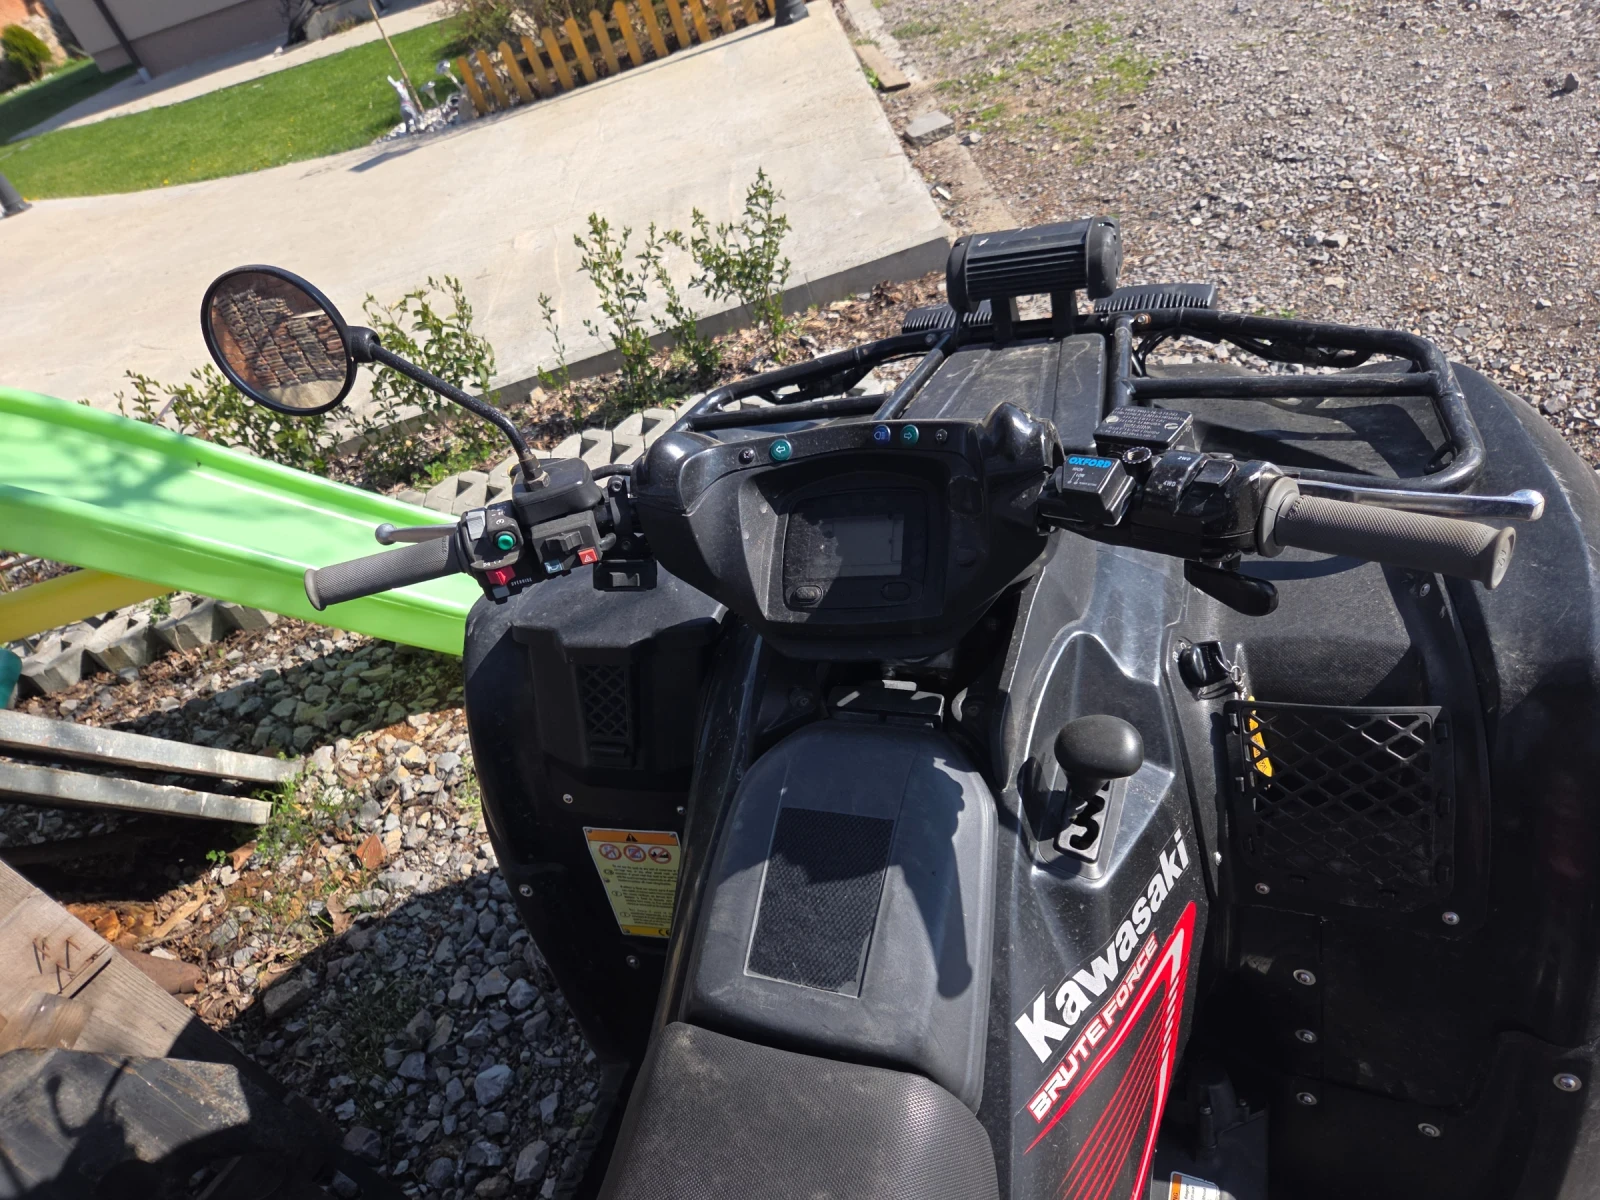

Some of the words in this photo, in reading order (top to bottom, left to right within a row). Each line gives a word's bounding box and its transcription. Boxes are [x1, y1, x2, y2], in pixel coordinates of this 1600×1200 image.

[1068, 456, 1112, 468] OXFORD
[1014, 828, 1190, 1063] Kawasaki
[1027, 1015, 1108, 1123] BRUTE
[1099, 932, 1158, 1028] FORCE
